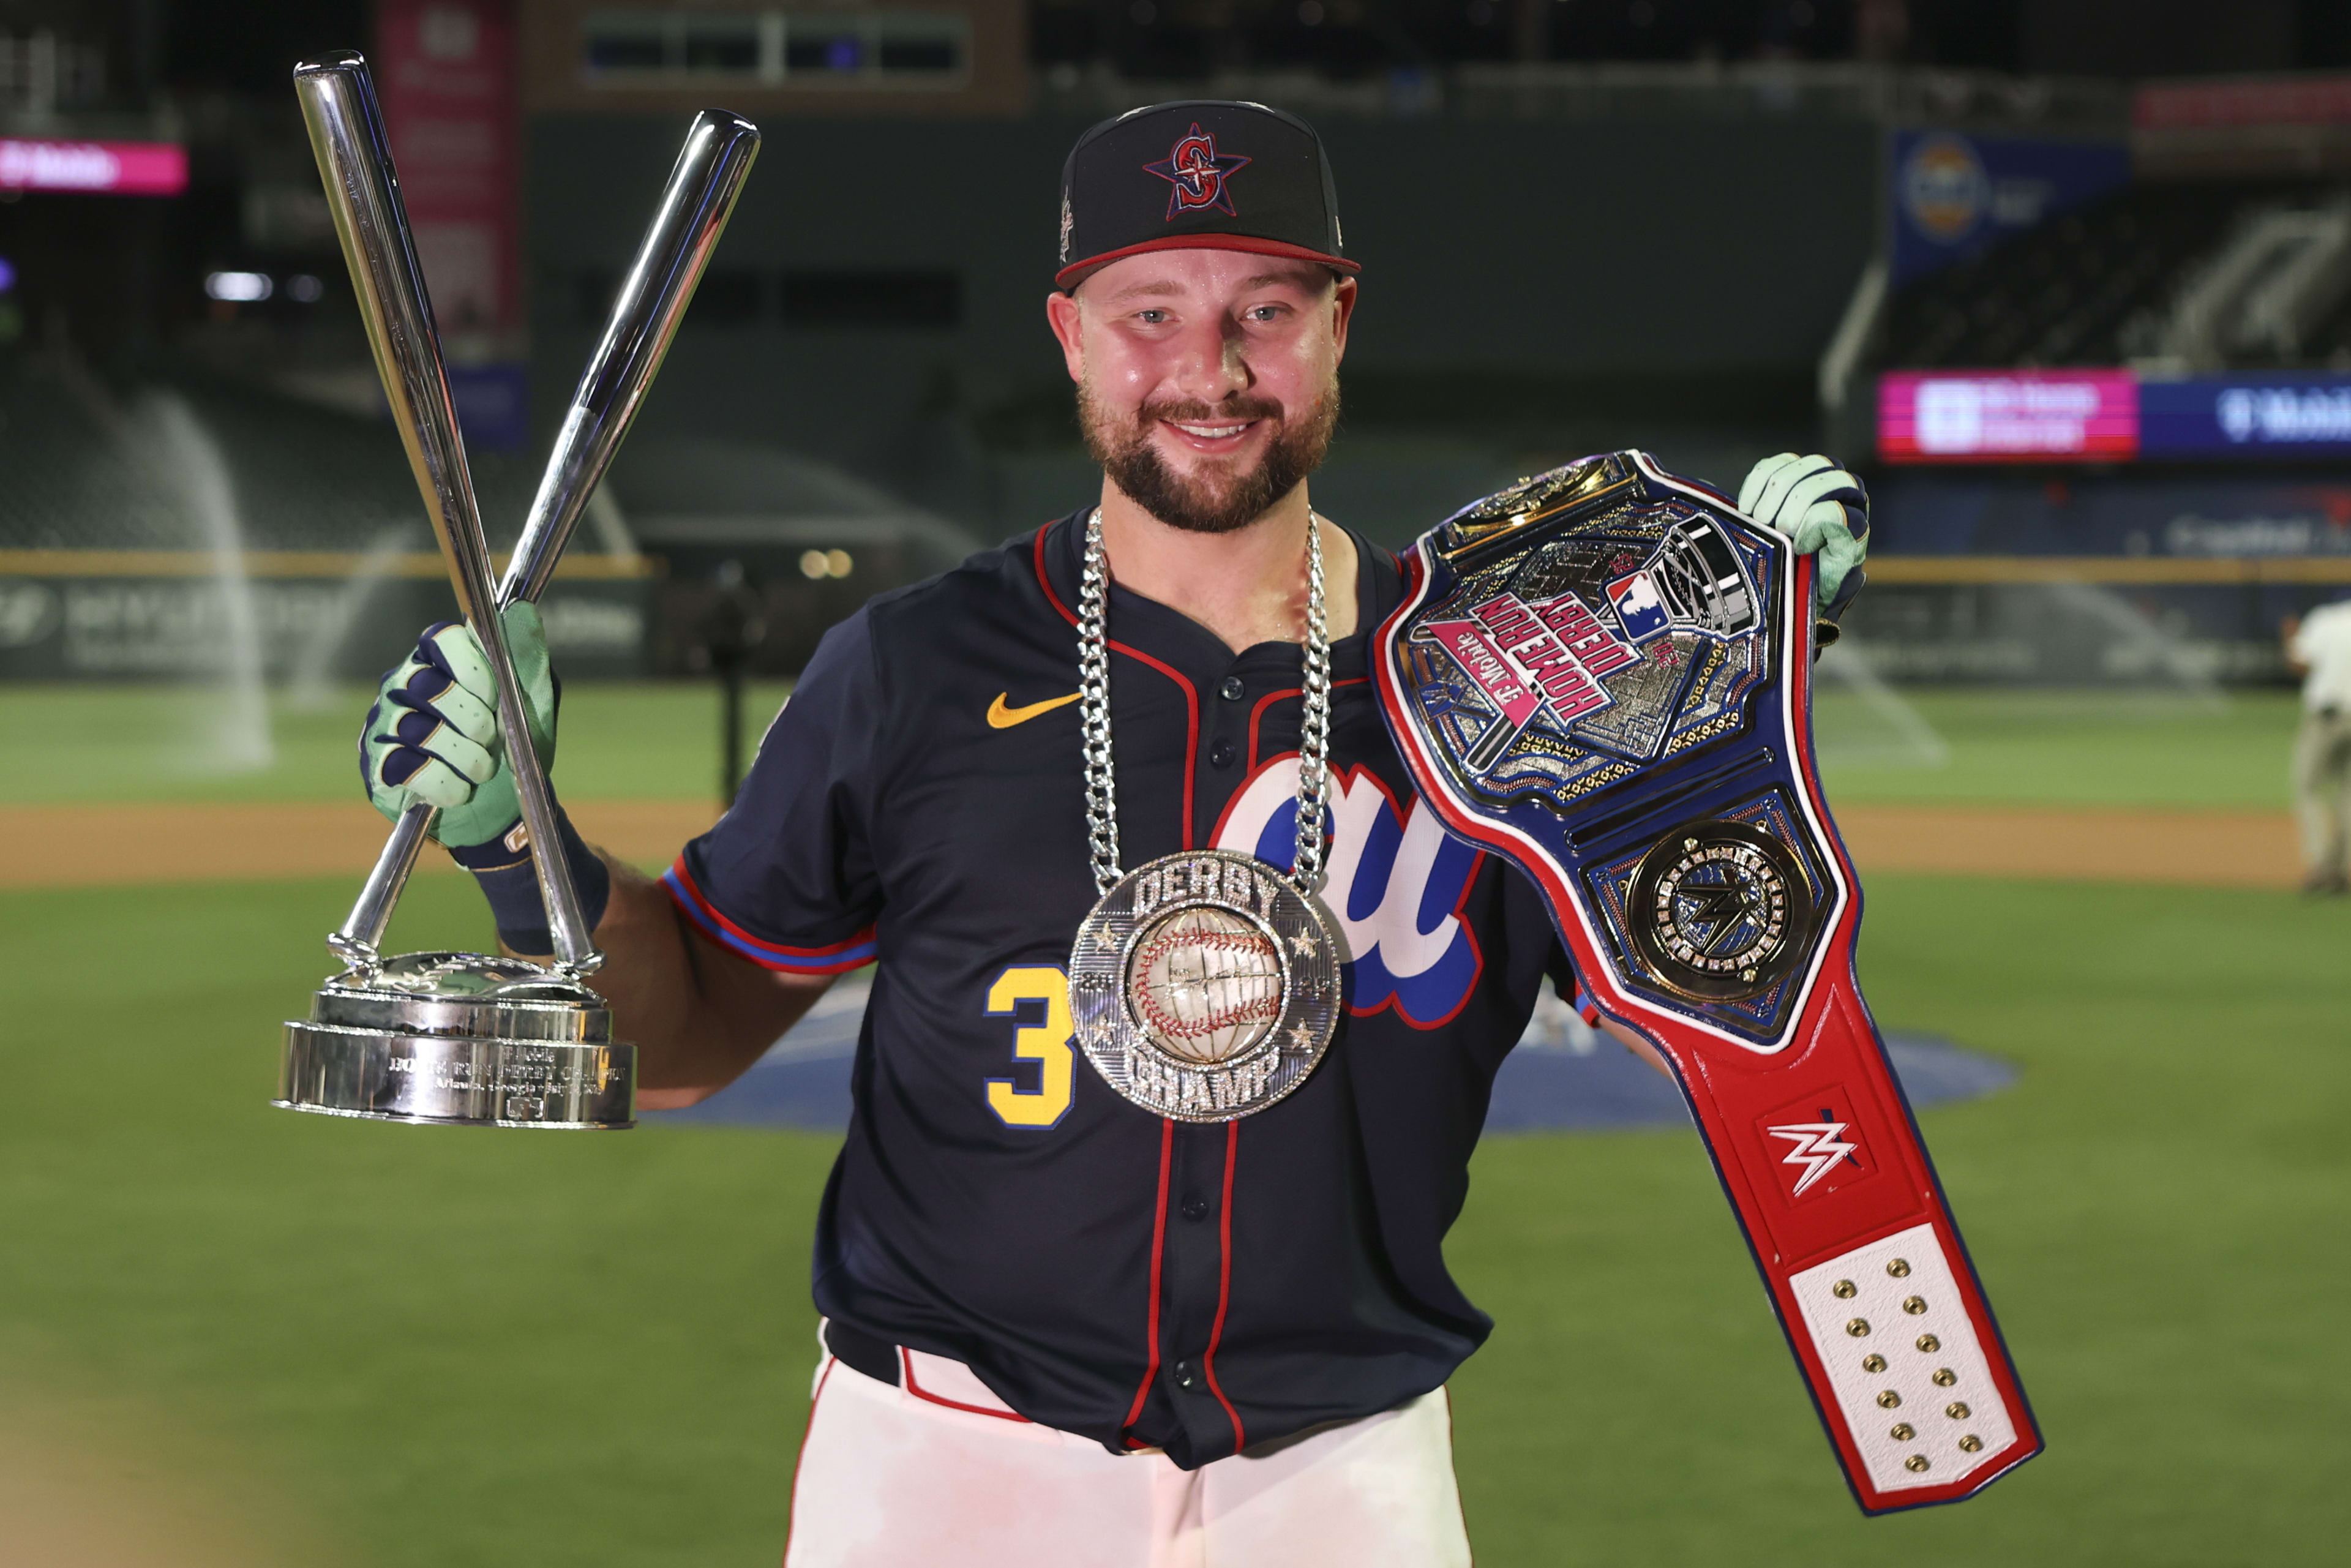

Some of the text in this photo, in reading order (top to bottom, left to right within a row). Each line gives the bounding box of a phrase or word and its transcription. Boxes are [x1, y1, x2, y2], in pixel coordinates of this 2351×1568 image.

[1172, 132, 1221, 209] S
[1455, 631, 1512, 689] Mobile
[1532, 595, 1640, 677] DERBY
[1133, 856, 1283, 920] DERBY
[1127, 1047, 1281, 1111] CHAMP
